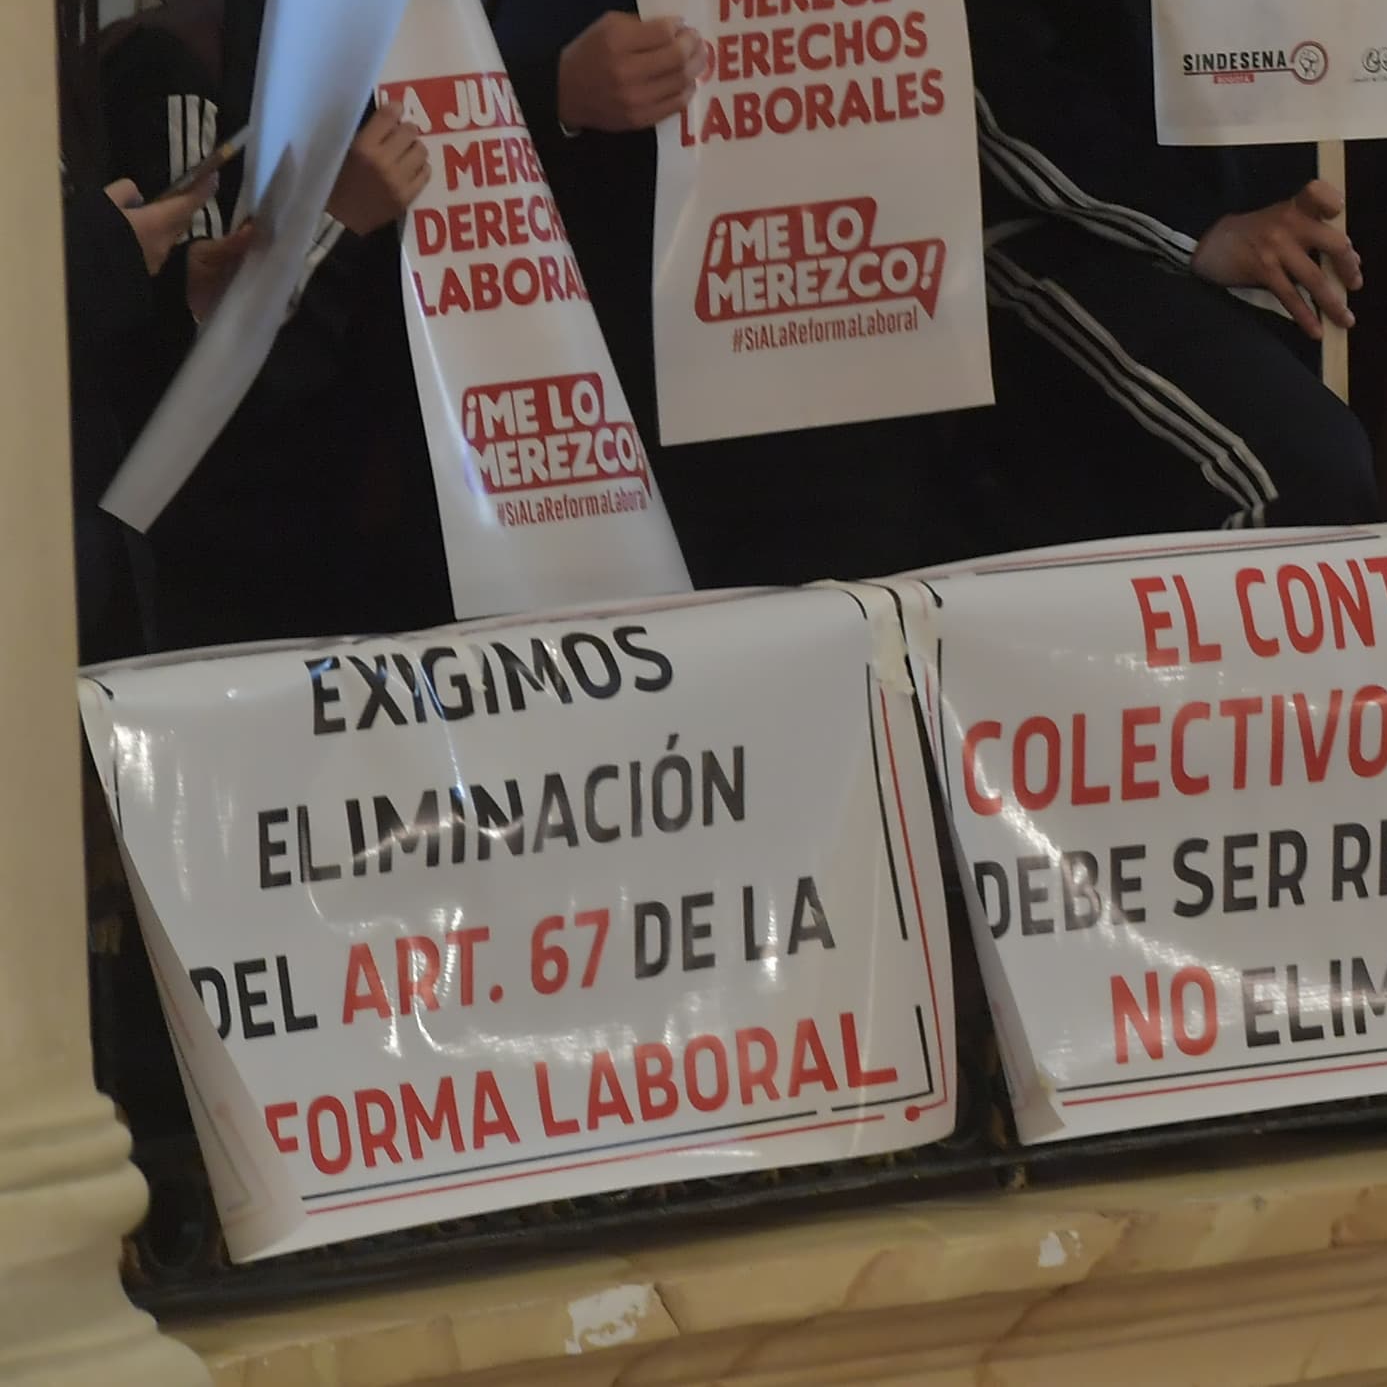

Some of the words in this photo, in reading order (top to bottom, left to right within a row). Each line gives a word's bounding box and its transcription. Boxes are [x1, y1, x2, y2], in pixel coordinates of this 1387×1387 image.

[680, 69, 944, 147] LABORALES
[1183, 50, 1287, 71] SINDESENA
[709, 213, 790, 261] ¡ME
[801, 206, 864, 254] LO
[707, 249, 935, 315] MEREZCO!
[467, 388, 539, 440] ¡ME
[547, 380, 601, 430] LO
[470, 426, 645, 488] MEREZCO!
[1132, 574, 1221, 669] EL
[304, 625, 674, 735] EXIGIMOS
[258, 734, 746, 889] ELIMINACIÓN
[975, 844, 1146, 940] DEBE
[1174, 828, 1309, 919] SER
[190, 955, 318, 1042] DEL
[341, 925, 505, 1026] ART.
[531, 907, 611, 996] 67
[633, 891, 715, 980] DE
[740, 875, 836, 961] LA
[1111, 965, 1218, 1064] NO
[539, 1011, 897, 1139] LABORAL
